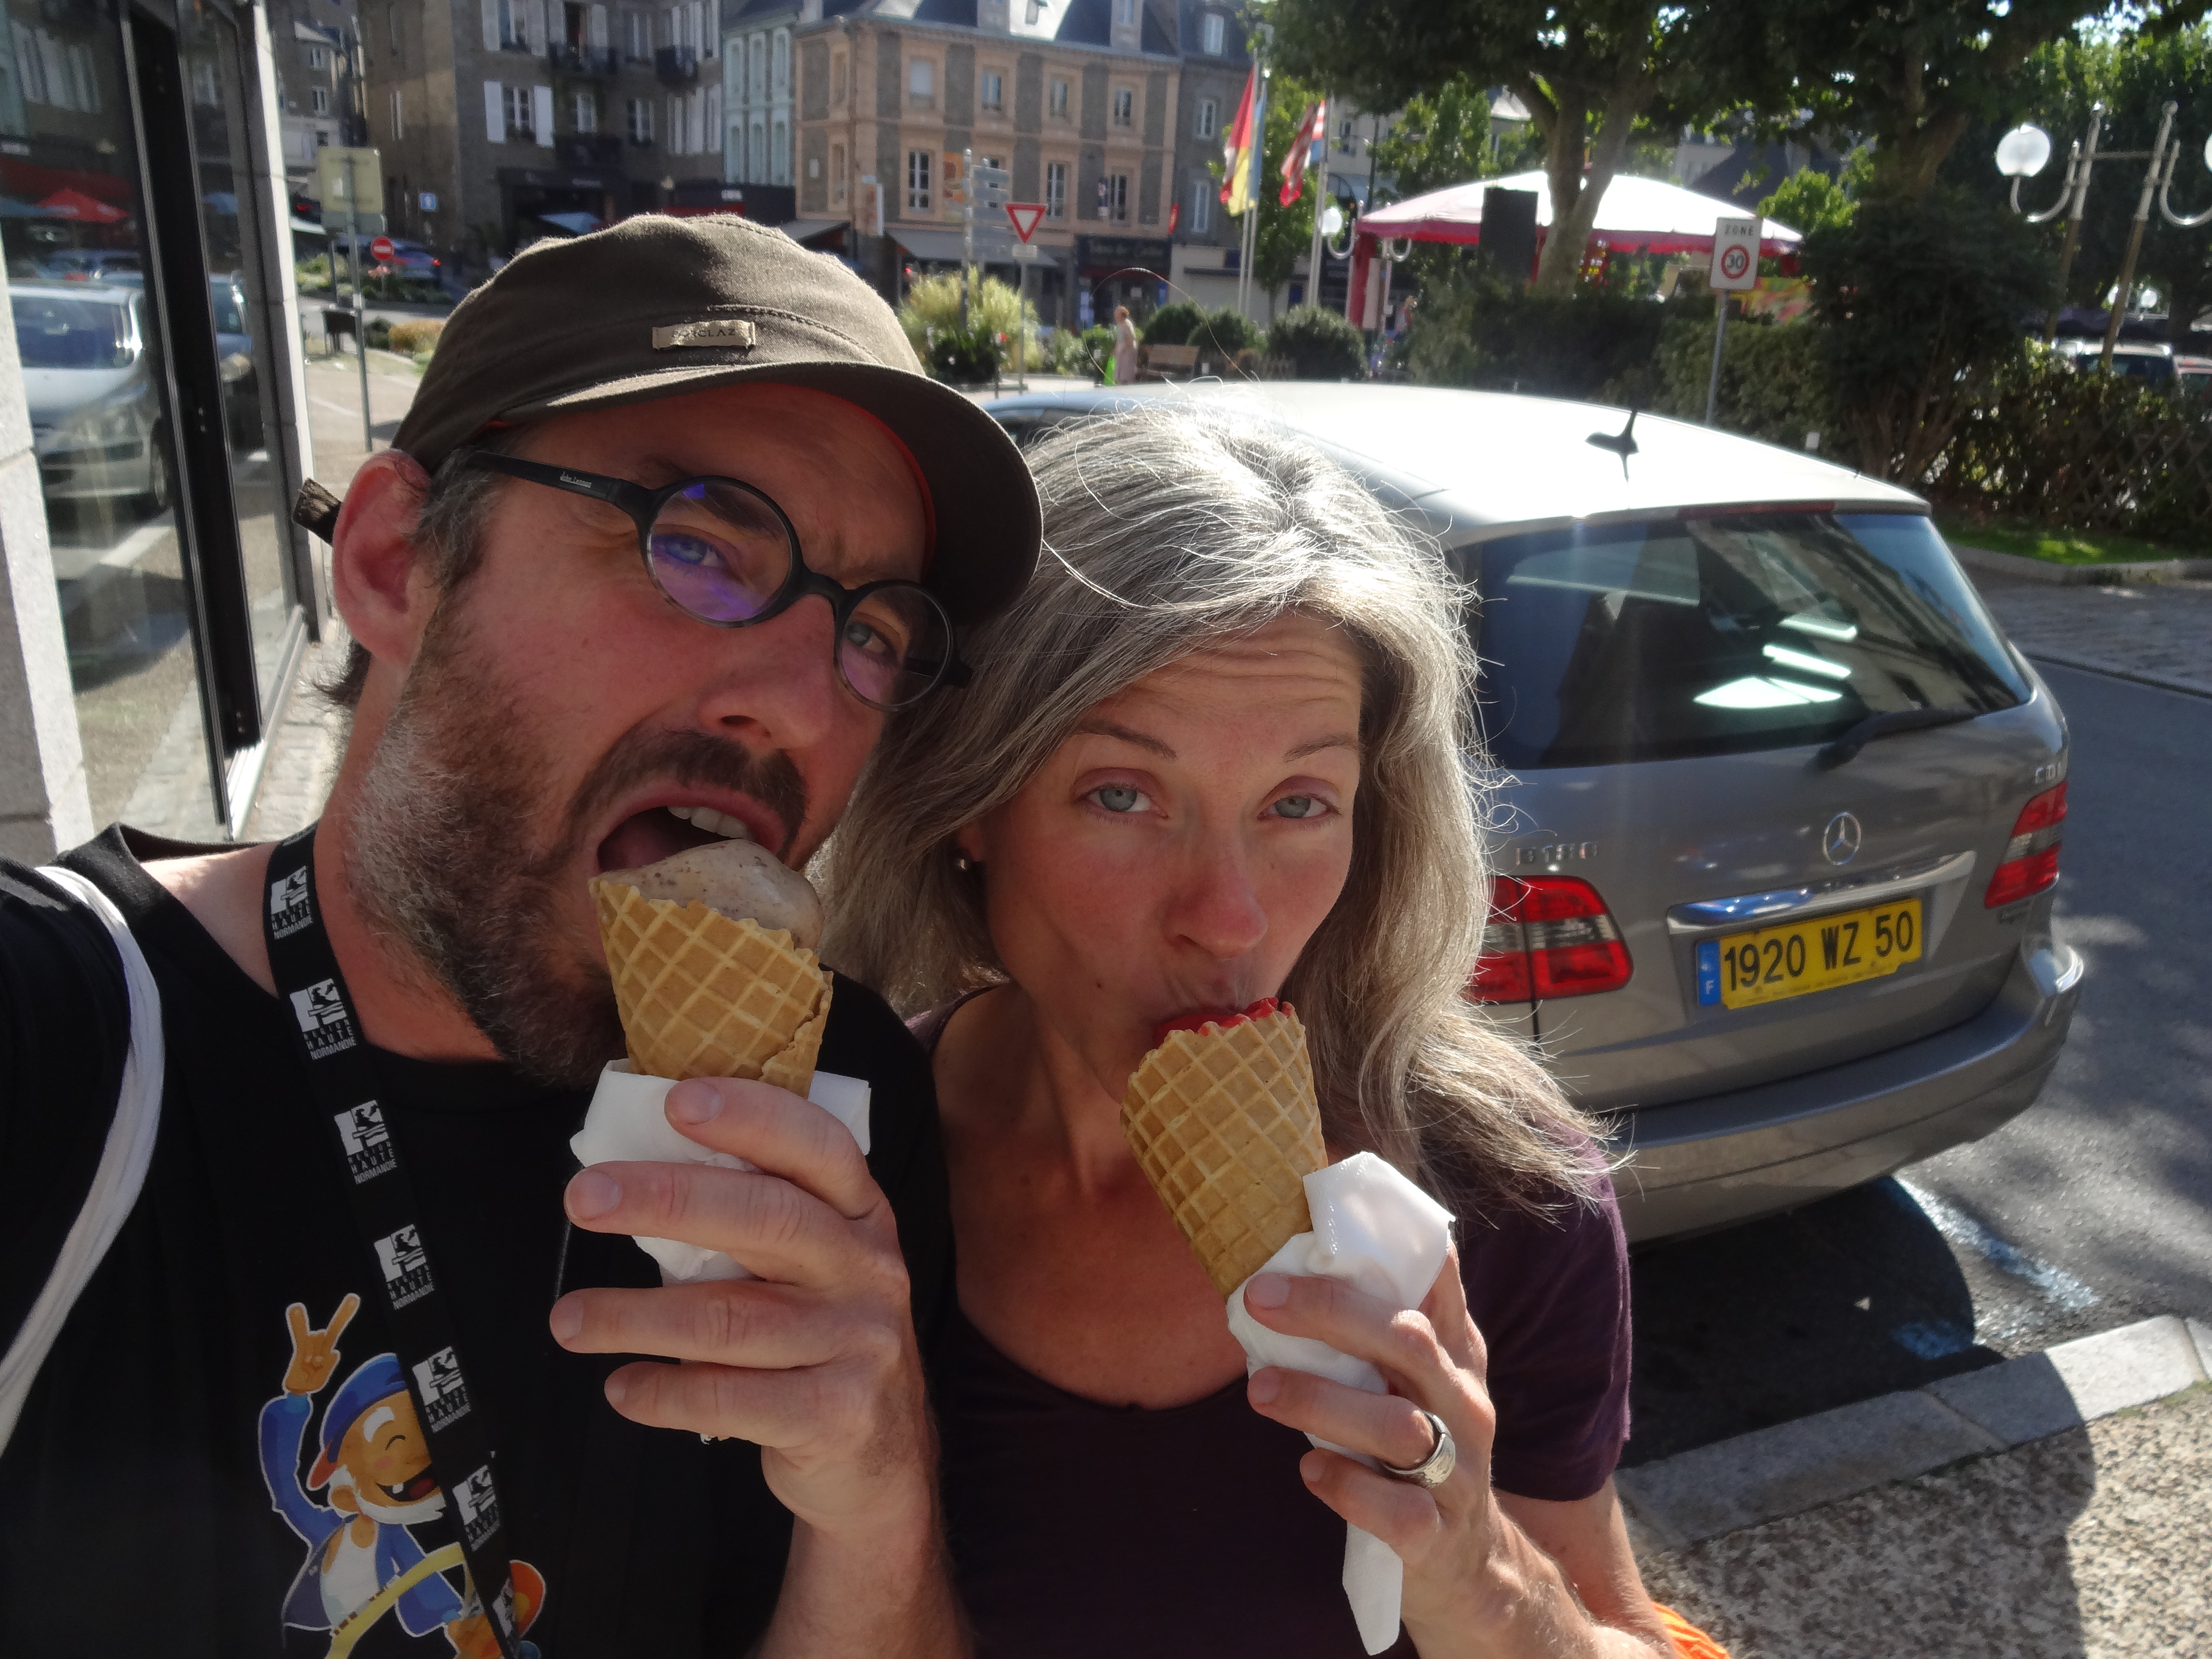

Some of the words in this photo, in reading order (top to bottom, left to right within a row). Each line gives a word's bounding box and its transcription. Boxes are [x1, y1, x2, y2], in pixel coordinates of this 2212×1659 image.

[1725, 224, 1753, 236] ZONE
[1727, 254, 1745, 269] 30
[272, 904, 311, 931] HAUTE
[1724, 934, 1806, 991] 1920
[1821, 921, 1862, 970] WZ
[1875, 910, 1914, 957] 50
[1705, 979, 1714, 994] F
[306, 1026, 353, 1050] HAUTE
[310, 1036, 357, 1060] NORMANDIE
[351, 1148, 394, 1174] HAUTE
[354, 1158, 397, 1185] NORMANDIE
[389, 1272, 432, 1300] HAUTE
